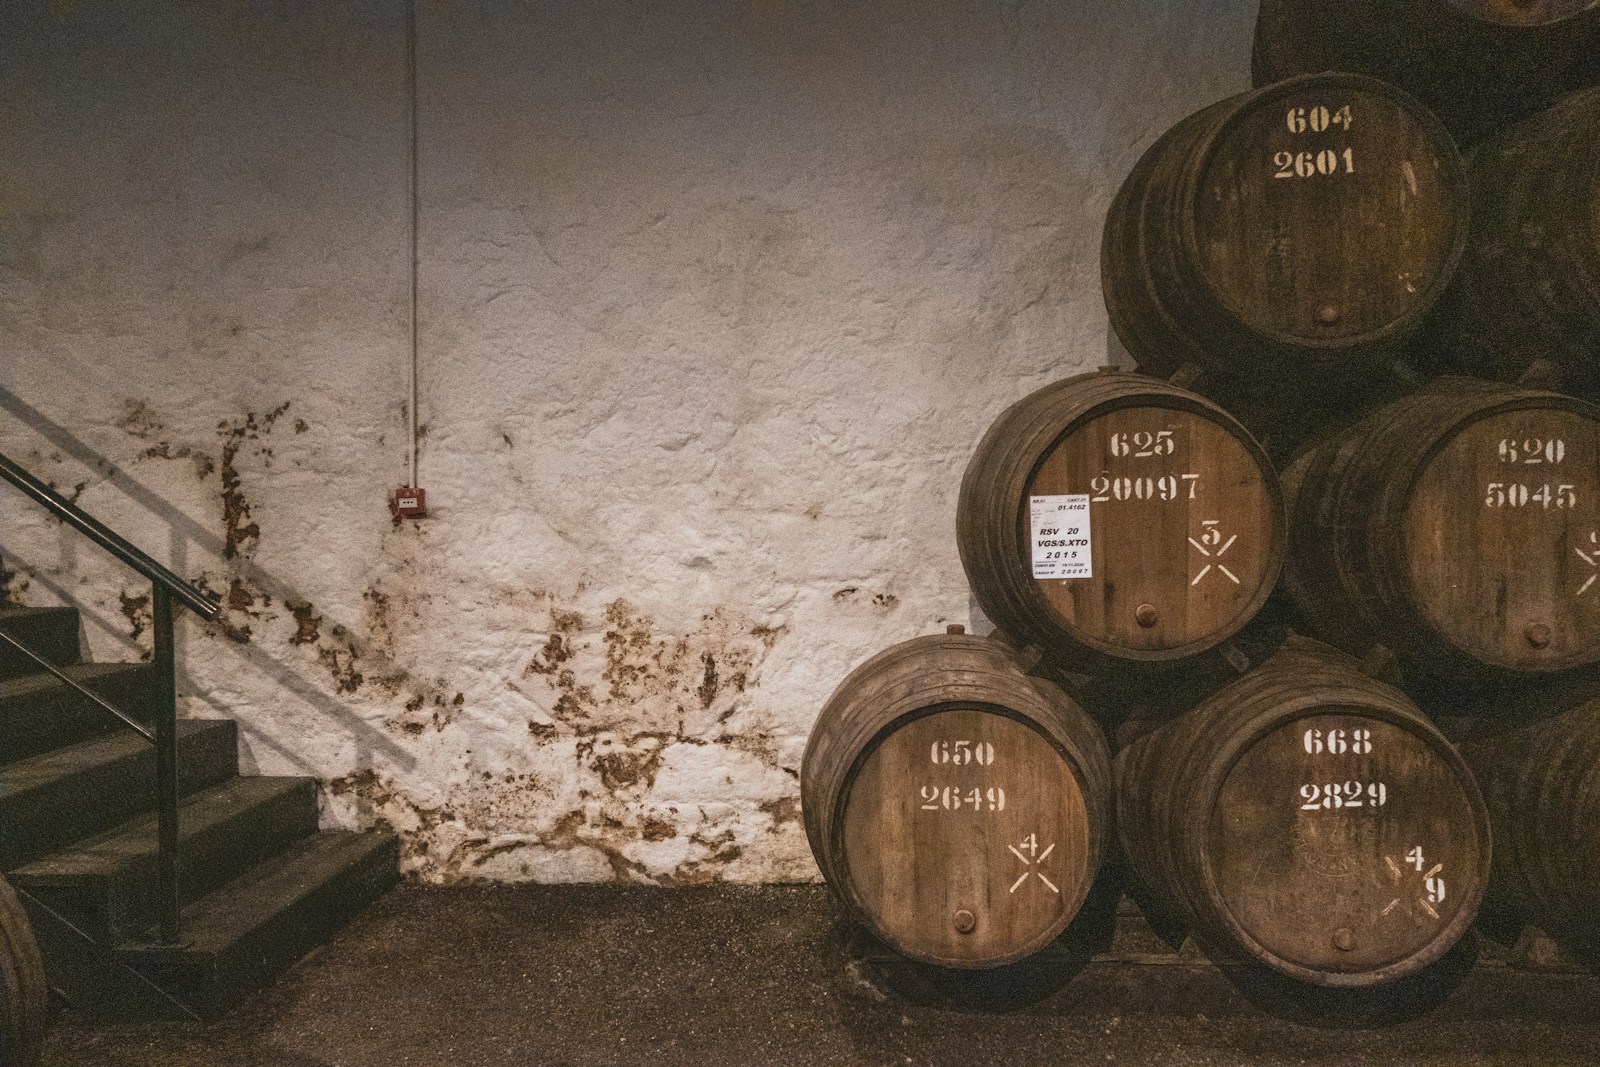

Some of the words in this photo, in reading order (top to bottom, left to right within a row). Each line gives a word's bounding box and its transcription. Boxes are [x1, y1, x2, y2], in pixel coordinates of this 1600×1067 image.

[1287, 105, 1353, 134] 604
[1273, 147, 1354, 179] 2601
[1110, 431, 1174, 457] 625
[1498, 438, 1565, 464] 620
[1090, 473, 1199, 502] 20097
[1485, 483, 1576, 509] 5045
[1037, 539, 1088, 547] VGS/S.XTO
[1039, 528, 1060, 536] RSV
[1067, 527, 1079, 535] 20
[1201, 520, 1221, 545] 5
[930, 740, 995, 766] 650
[1303, 729, 1373, 755] 668
[920, 786, 1006, 811] 2649
[1300, 780, 1387, 810] 2829
[1019, 833, 1039, 857] 4
[1405, 845, 1425, 871] 4
[1425, 878, 1446, 903] 9
